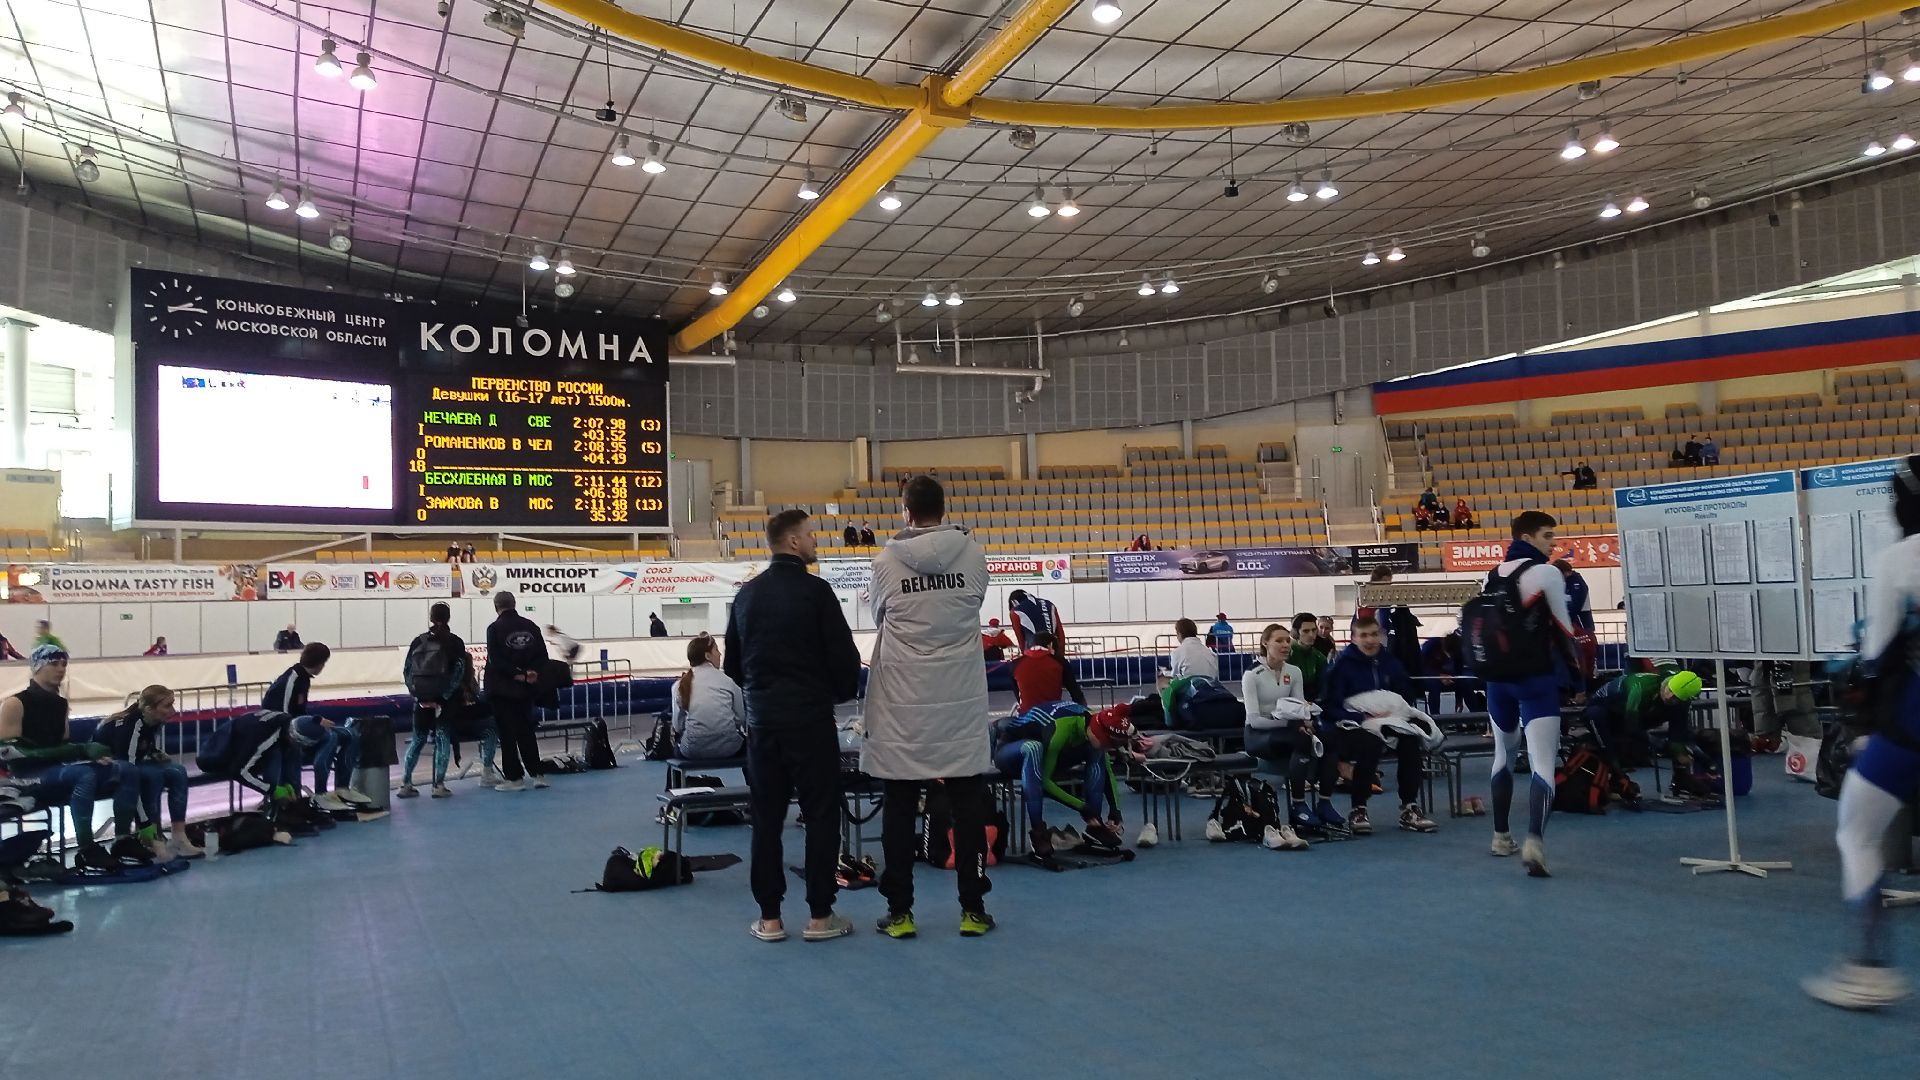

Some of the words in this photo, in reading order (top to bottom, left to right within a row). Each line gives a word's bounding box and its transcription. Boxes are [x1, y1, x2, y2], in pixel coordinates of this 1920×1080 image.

[216, 299, 336, 323] КОНЬКОБЕЖНЫЙ
[345, 313, 386, 328] ЦЕНТР
[215, 319, 318, 340] МОСКОВСКОЙ
[326, 330, 387, 347] ОБЛАСТИ
[420, 322, 653, 363] КОЛОМНА
[471, 376, 551, 393] ПЕРВЕНСТВО
[557, 381, 604, 395] РОССИИ
[432, 387, 490, 402] Девушки
[498, 391, 544, 404] (16-17
[550, 394, 581, 406] лет)
[588, 395, 632, 408] 1500м.
[424, 411, 482, 426] НЕЧАЕВА
[489, 413, 498, 427] Д
[527, 415, 552, 428] СВЕ
[573, 416, 627, 430] 2:07.98
[641, 419, 661, 432] (3)
[582, 429, 627, 442] +03.52
[424, 435, 506, 450] РОМАНЕНКОВ
[527, 438, 553, 451] ЧЕЛ
[574, 440, 627, 453] 2:08.95
[641, 441, 662, 454] (5)
[583, 453, 627, 464] +04.49
[409, 459, 427, 472] 18
[425, 472, 507, 486] БЕСХЛЕБНАЯ
[528, 474, 553, 487] МОС
[574, 475, 628, 487] 2:11.44
[635, 476, 662, 488] (12)
[583, 487, 628, 498] +06.98
[1856, 486, 1896, 496] СТАРТОВ
[425, 497, 484, 510] ЗАЙКОВА
[528, 498, 554, 510] МОС
[574, 498, 628, 511] 2:11.48
[635, 499, 663, 511] (13)
[1665, 504, 1702, 514] ИТОГОВЫЕ
[1703, 501, 1747, 512] ПРОТОКОЛЫ
[589, 510, 629, 522] 35.92
[1452, 545, 1503, 559] ЗИМА
[1113, 555, 1142, 563] EXEED
[506, 567, 599, 579] МИНСПОРТ
[987, 562, 1038, 572] ОРГАНОВ
[52, 579, 130, 591] KOLOMNA
[134, 578, 178, 590] TASTY
[182, 578, 214, 590] FISH
[642, 575, 715, 584] КОНЬКОБЕЖЦЕВ
[901, 572, 965, 594] BELARUS
[519, 582, 587, 594] РОССИИ
[639, 585, 676, 593] РОССИИ
